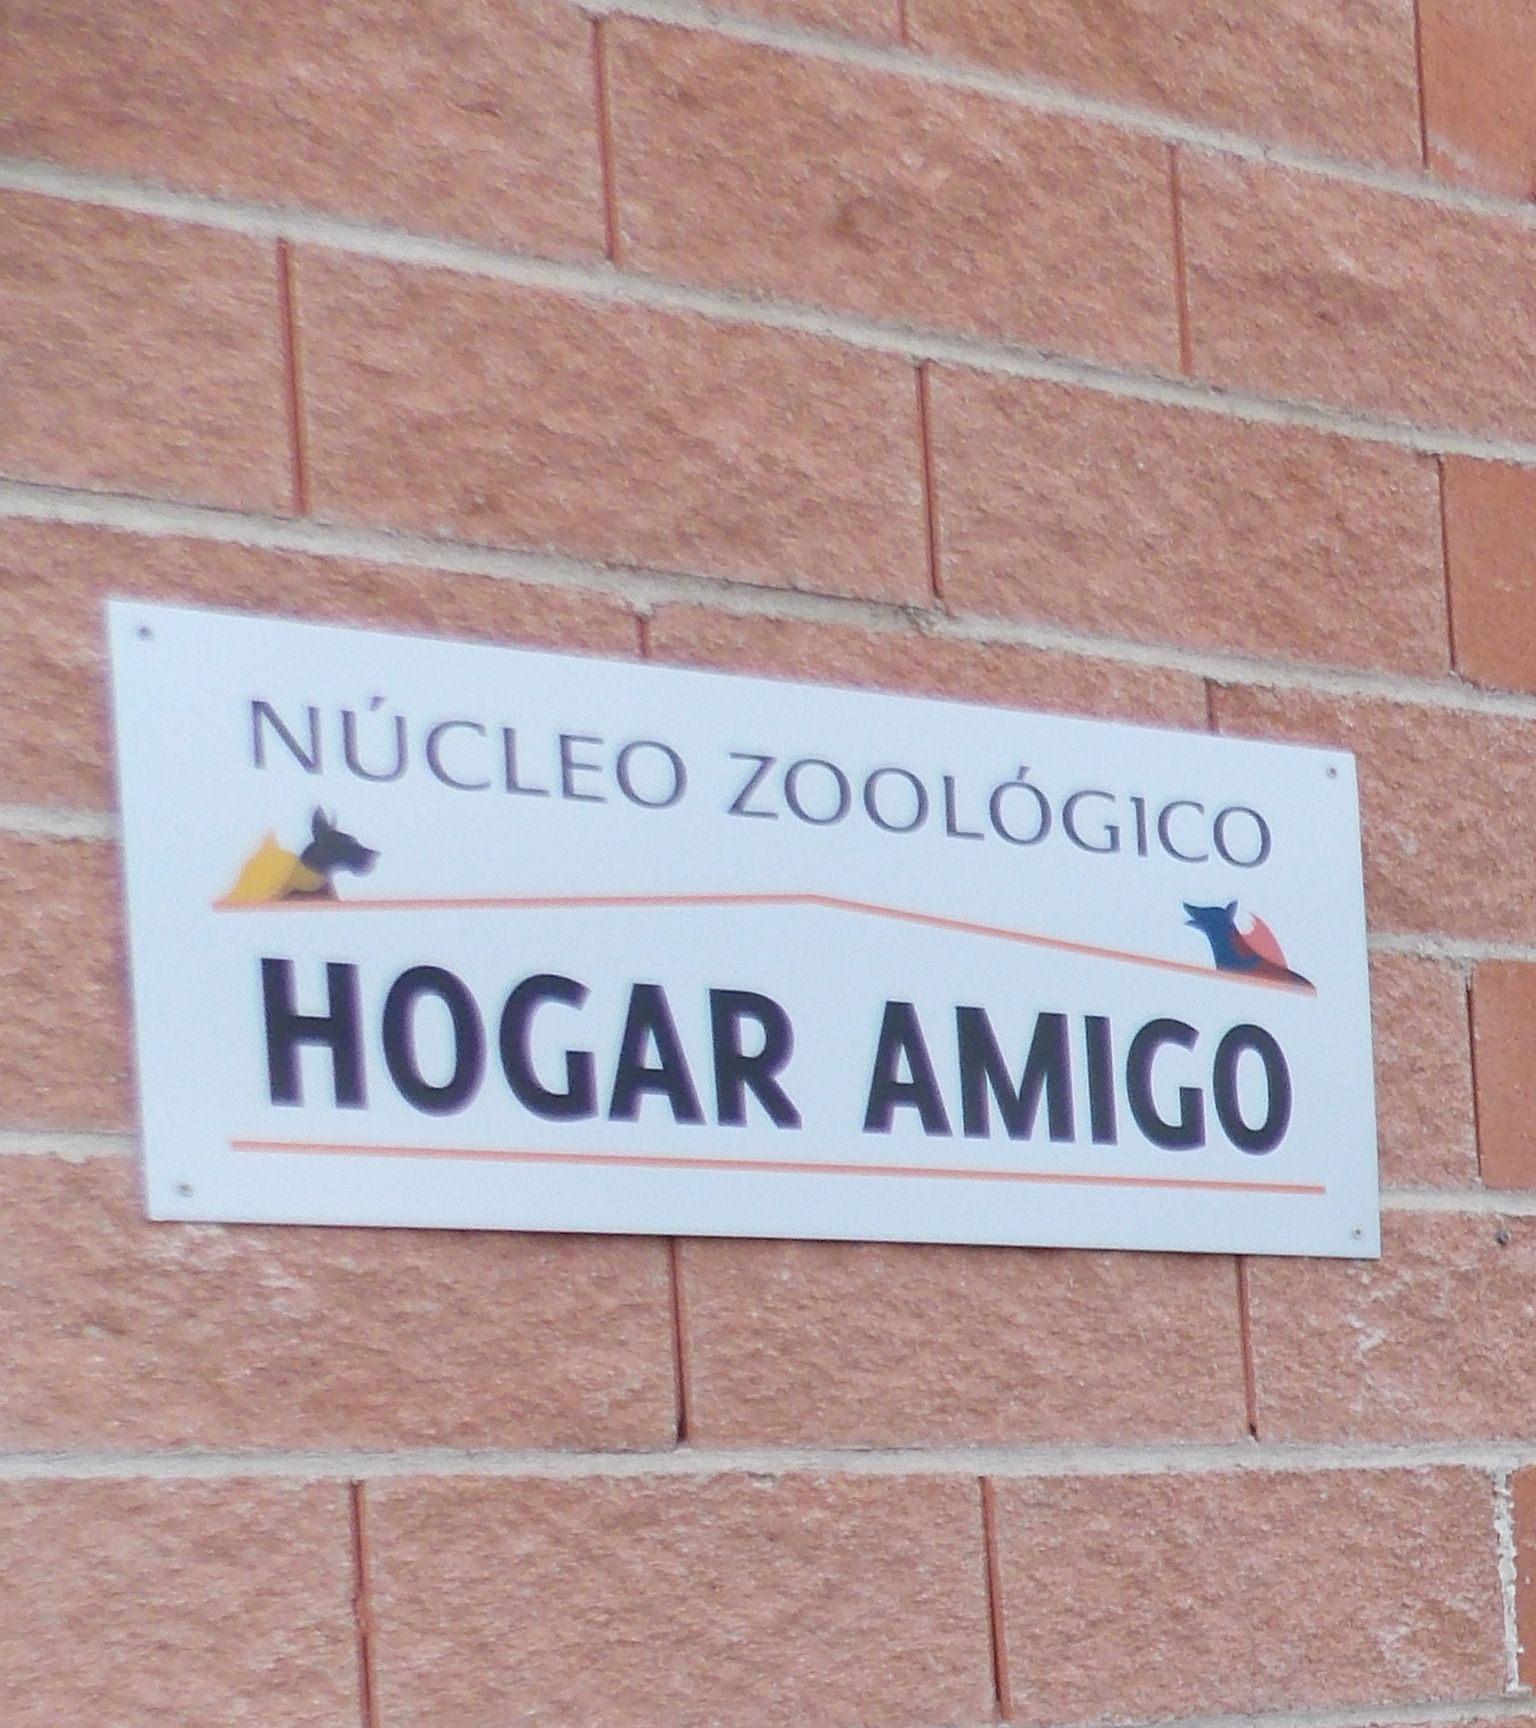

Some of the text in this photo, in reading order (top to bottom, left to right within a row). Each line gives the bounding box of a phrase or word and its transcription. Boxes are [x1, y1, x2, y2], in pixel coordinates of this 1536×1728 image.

[250, 692, 1272, 869] NÚCLEO ZOOLÓGICO
[259, 956, 1292, 1155] HOGAR AMIGO
